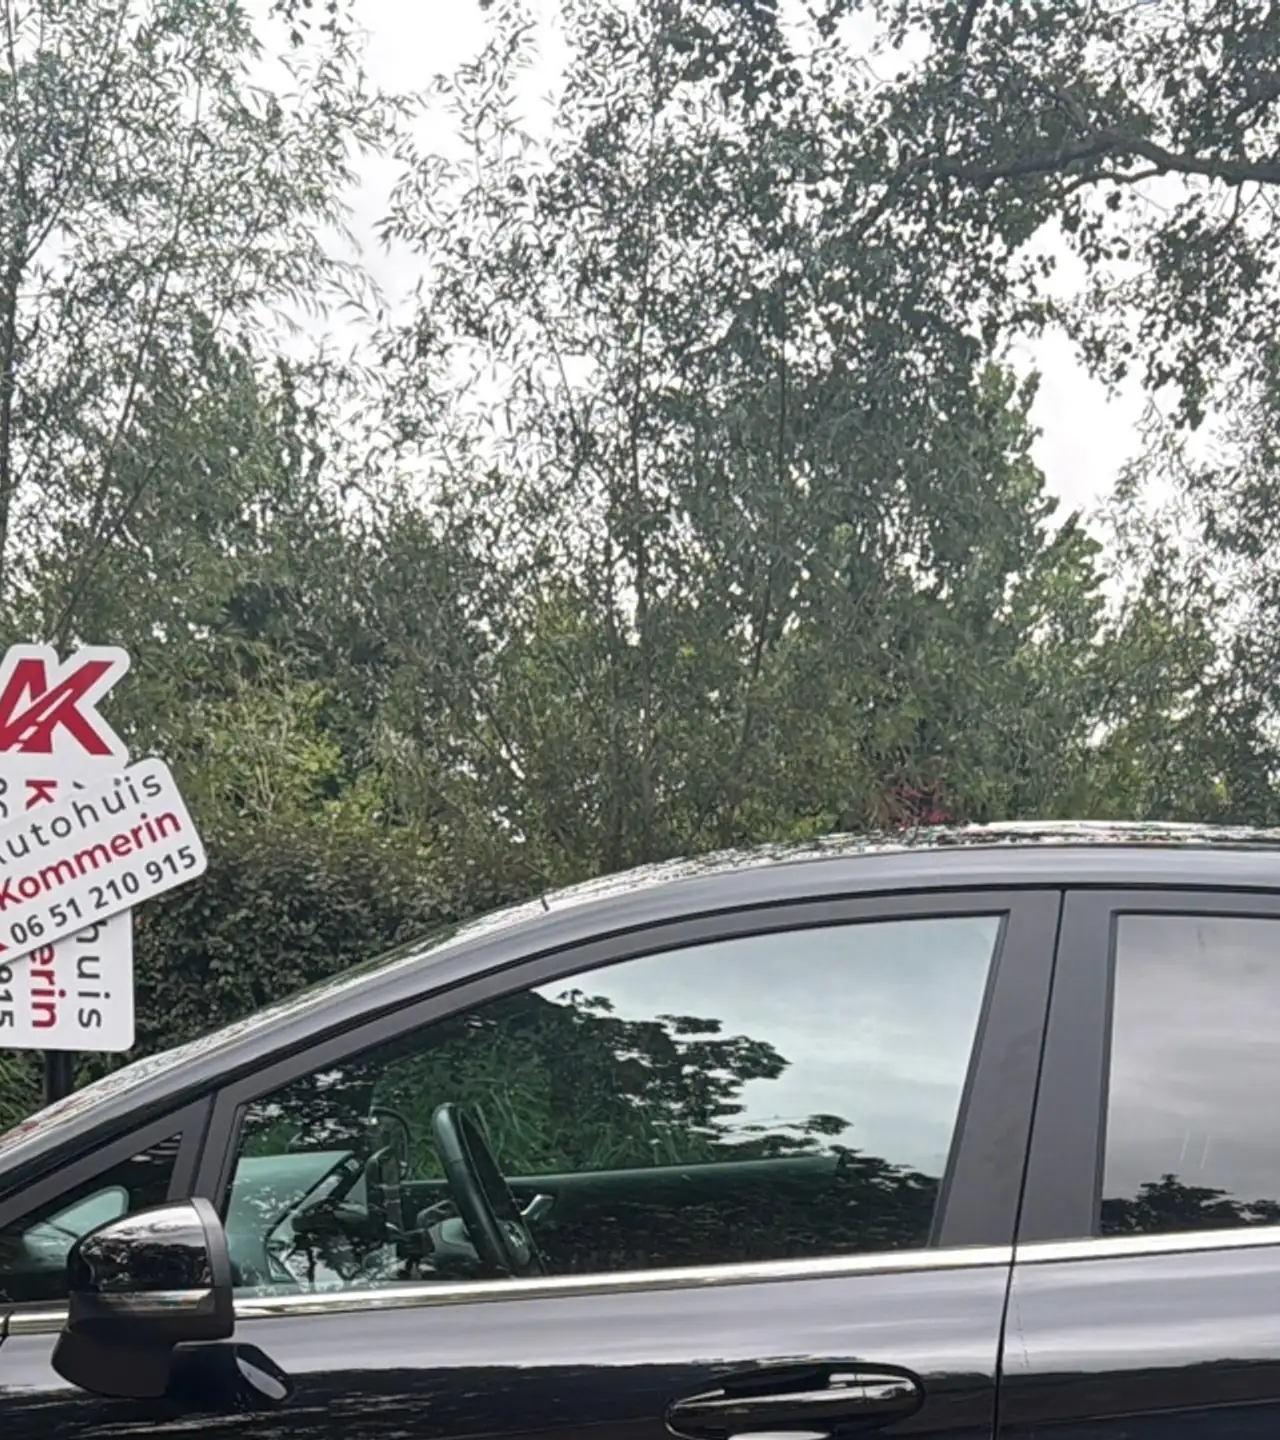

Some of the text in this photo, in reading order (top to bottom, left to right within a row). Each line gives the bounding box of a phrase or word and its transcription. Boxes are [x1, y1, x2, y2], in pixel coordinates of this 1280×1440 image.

[10, 844, 197, 945] 06 51 210 915
